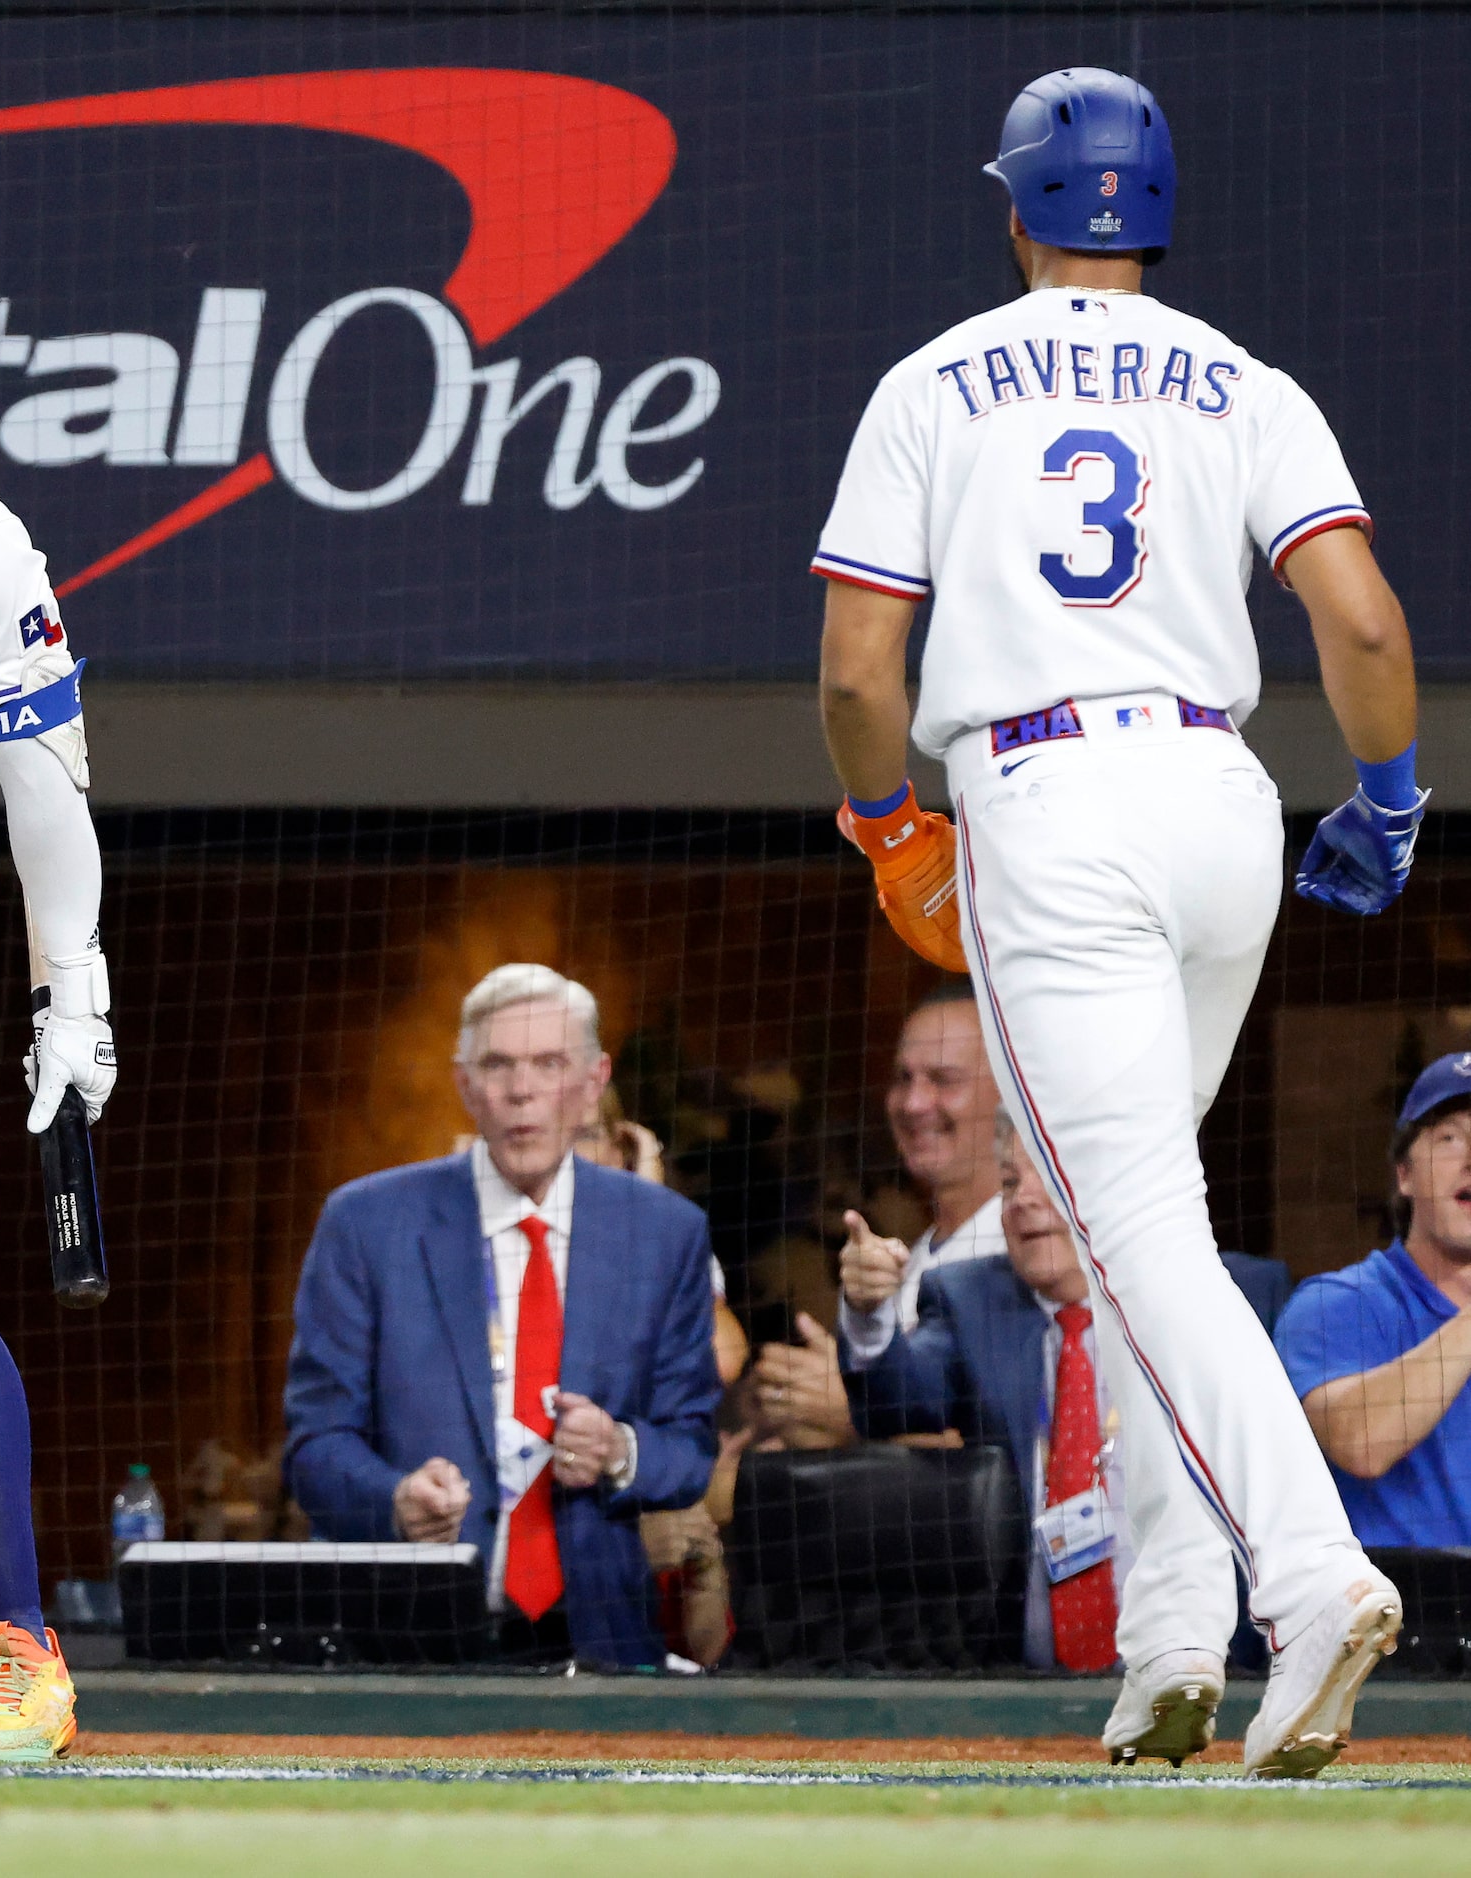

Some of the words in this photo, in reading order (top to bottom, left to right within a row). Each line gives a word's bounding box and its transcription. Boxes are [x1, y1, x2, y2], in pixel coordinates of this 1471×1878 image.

[1101, 171, 1118, 196] 3
[1089, 224, 1122, 232] SERIES
[1090, 217, 1122, 225] WORLD
[937, 339, 1243, 421] TAVERAS
[1036, 428, 1151, 608] 3
